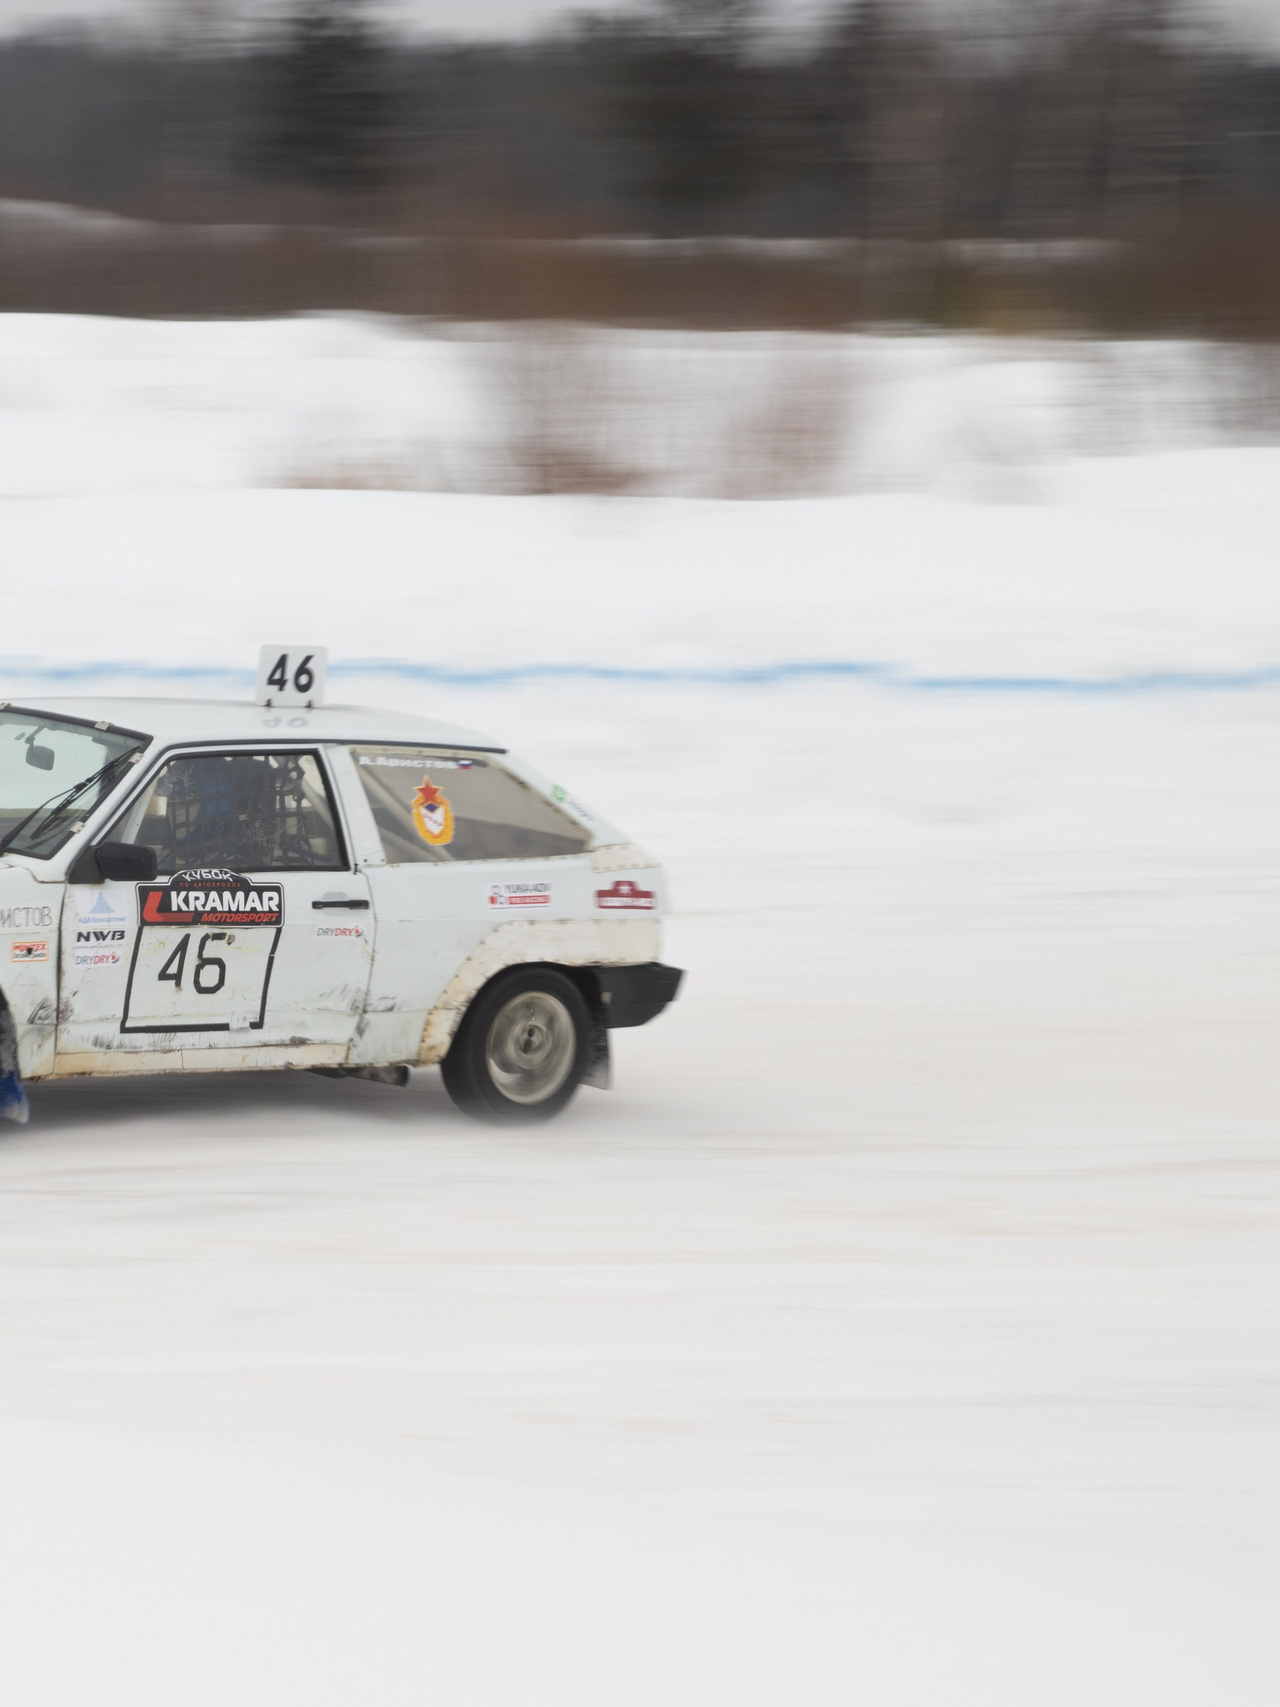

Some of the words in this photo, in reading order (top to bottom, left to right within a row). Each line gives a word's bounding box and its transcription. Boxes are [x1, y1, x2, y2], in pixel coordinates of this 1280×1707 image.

[267, 653, 315, 693] 46
[181, 869, 234, 882] КУБОК
[170, 891, 280, 912] KRAMAR
[200, 913, 279, 922] MOTORSPORT
[76, 930, 126, 943] NWB
[316, 927, 354, 937] DRYDRY
[75, 954, 111, 965] DRYDRY
[157, 932, 228, 995] 46
